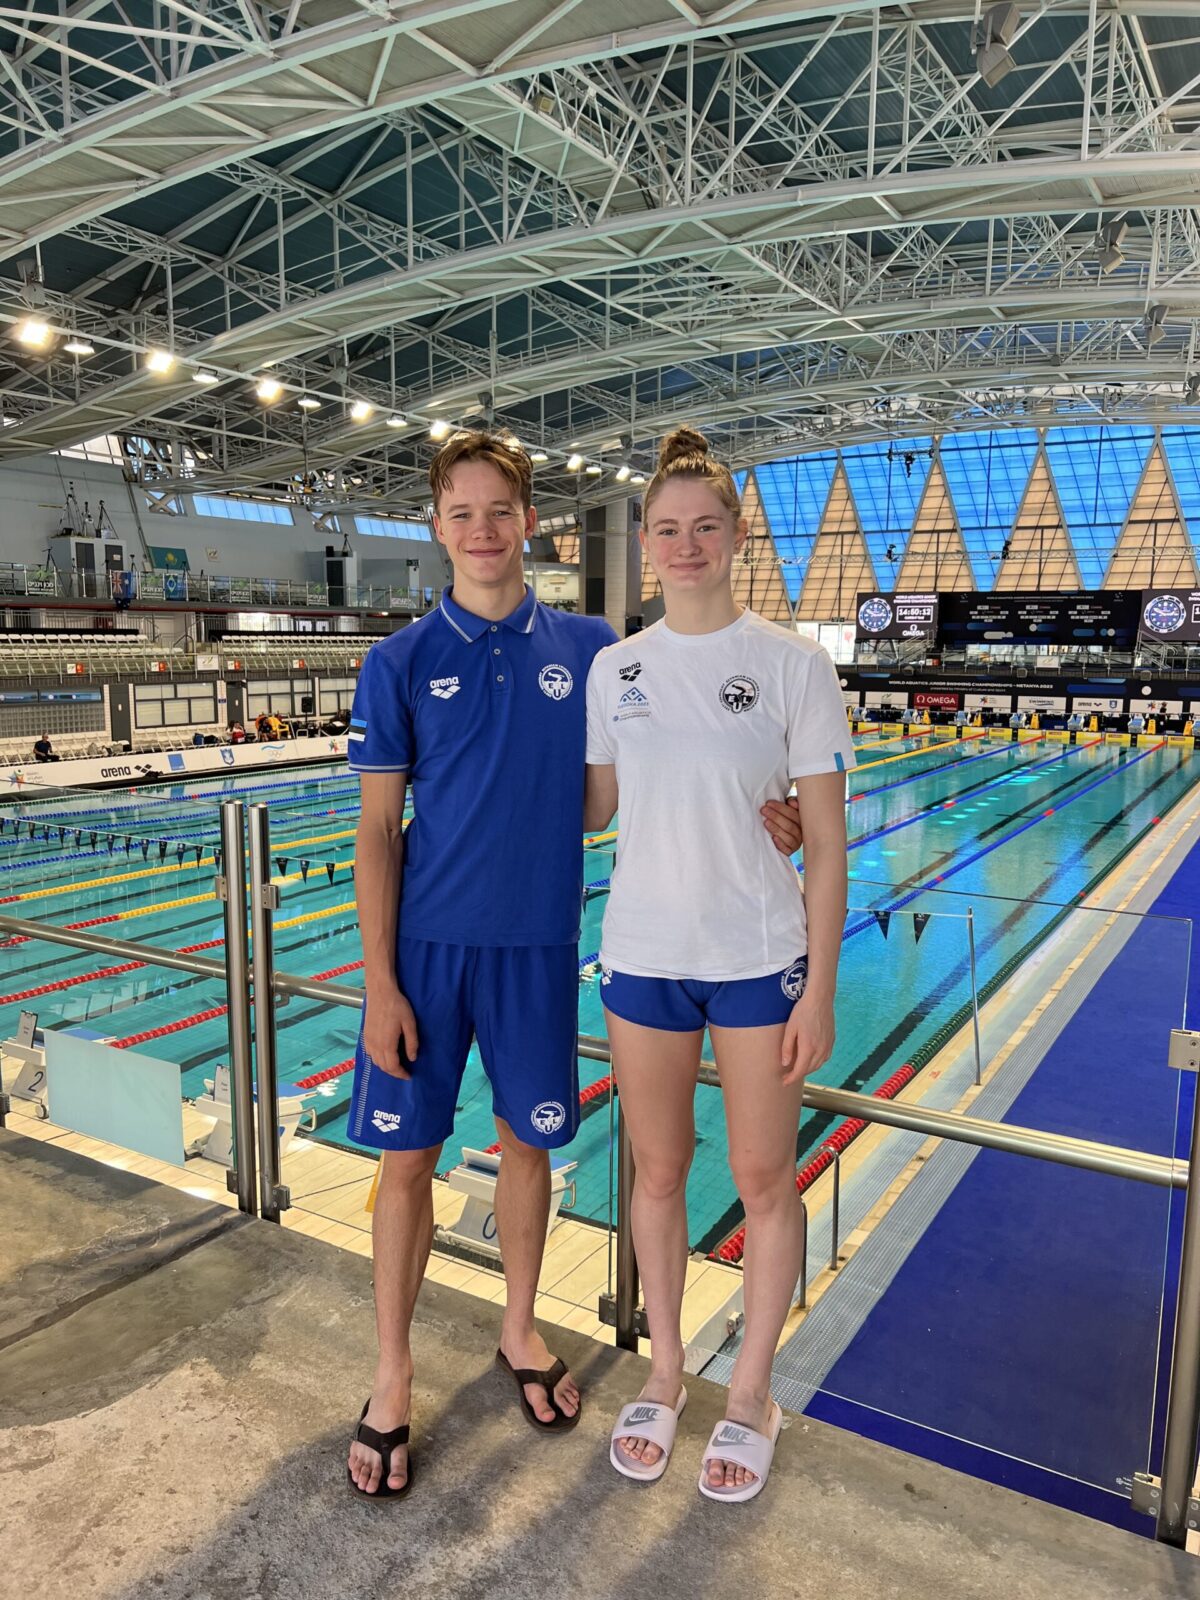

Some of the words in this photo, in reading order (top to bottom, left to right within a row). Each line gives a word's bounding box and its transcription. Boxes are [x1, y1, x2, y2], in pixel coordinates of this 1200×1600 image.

[619, 662, 641, 675] arena
[430, 676, 460, 689] arena
[926, 696, 956, 704] OMEGA
[101, 766, 131, 778] arena
[28, 1071, 44, 1092] 2
[373, 1110, 401, 1123] arena
[631, 1406, 660, 1420] NIKE
[720, 1425, 751, 1441] NIKE
